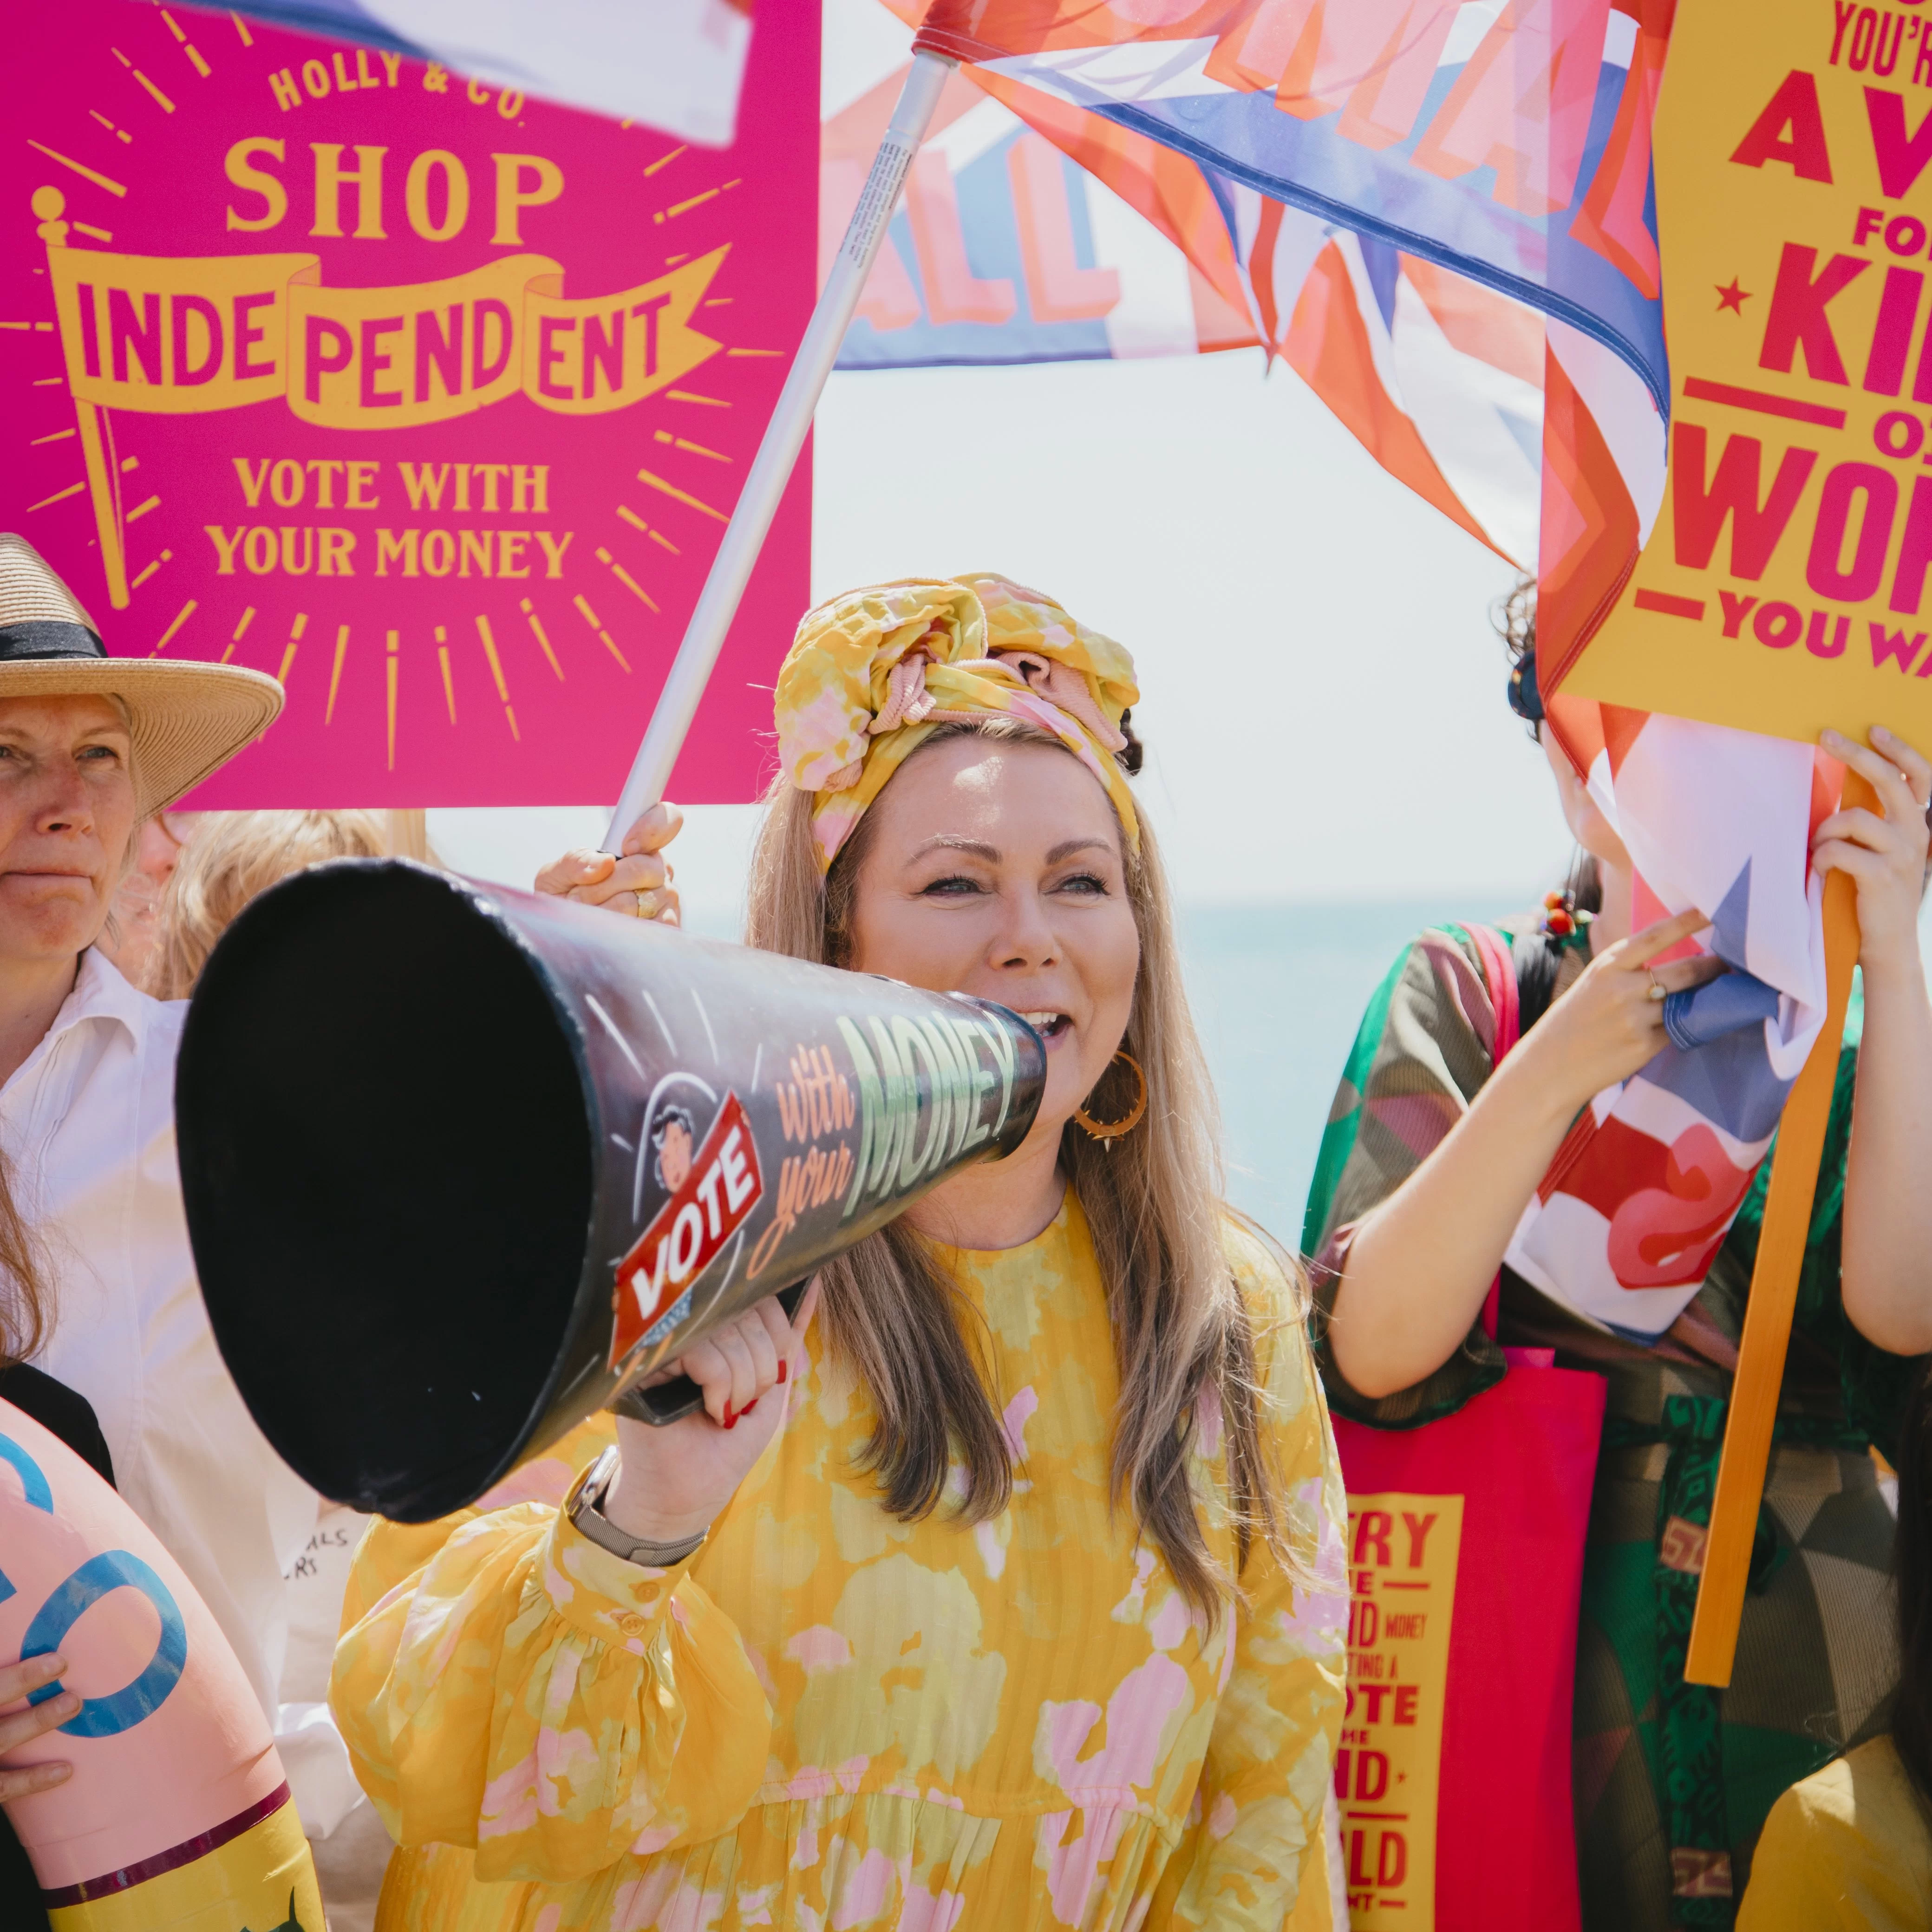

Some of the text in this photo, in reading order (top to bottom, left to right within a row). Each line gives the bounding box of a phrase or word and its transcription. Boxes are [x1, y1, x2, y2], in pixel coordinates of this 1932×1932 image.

[268, 49, 401, 112] HOLLY
[422, 60, 449, 94] &
[224, 137, 565, 245] SHOP
[1852, 205, 1932, 261] FO
[76, 281, 672, 408] INDEPENDENT
[1758, 241, 1932, 405] KI
[1873, 410, 1932, 465] O
[232, 457, 550, 513] VOTE WITH
[203, 525, 574, 579] YOUR MONEY
[1718, 588, 1852, 659] YOU
[777, 1043, 855, 1144] with
[837, 1010, 1014, 1217] MONEY
[631, 1123, 755, 1320] VOTE
[747, 1140, 855, 1280] your
[1348, 1511, 1438, 1568] RY
[1385, 1613, 1428, 1639] MONEY
[1389, 1654, 1398, 1680] A
[1340, 1830, 1408, 1888] LD
